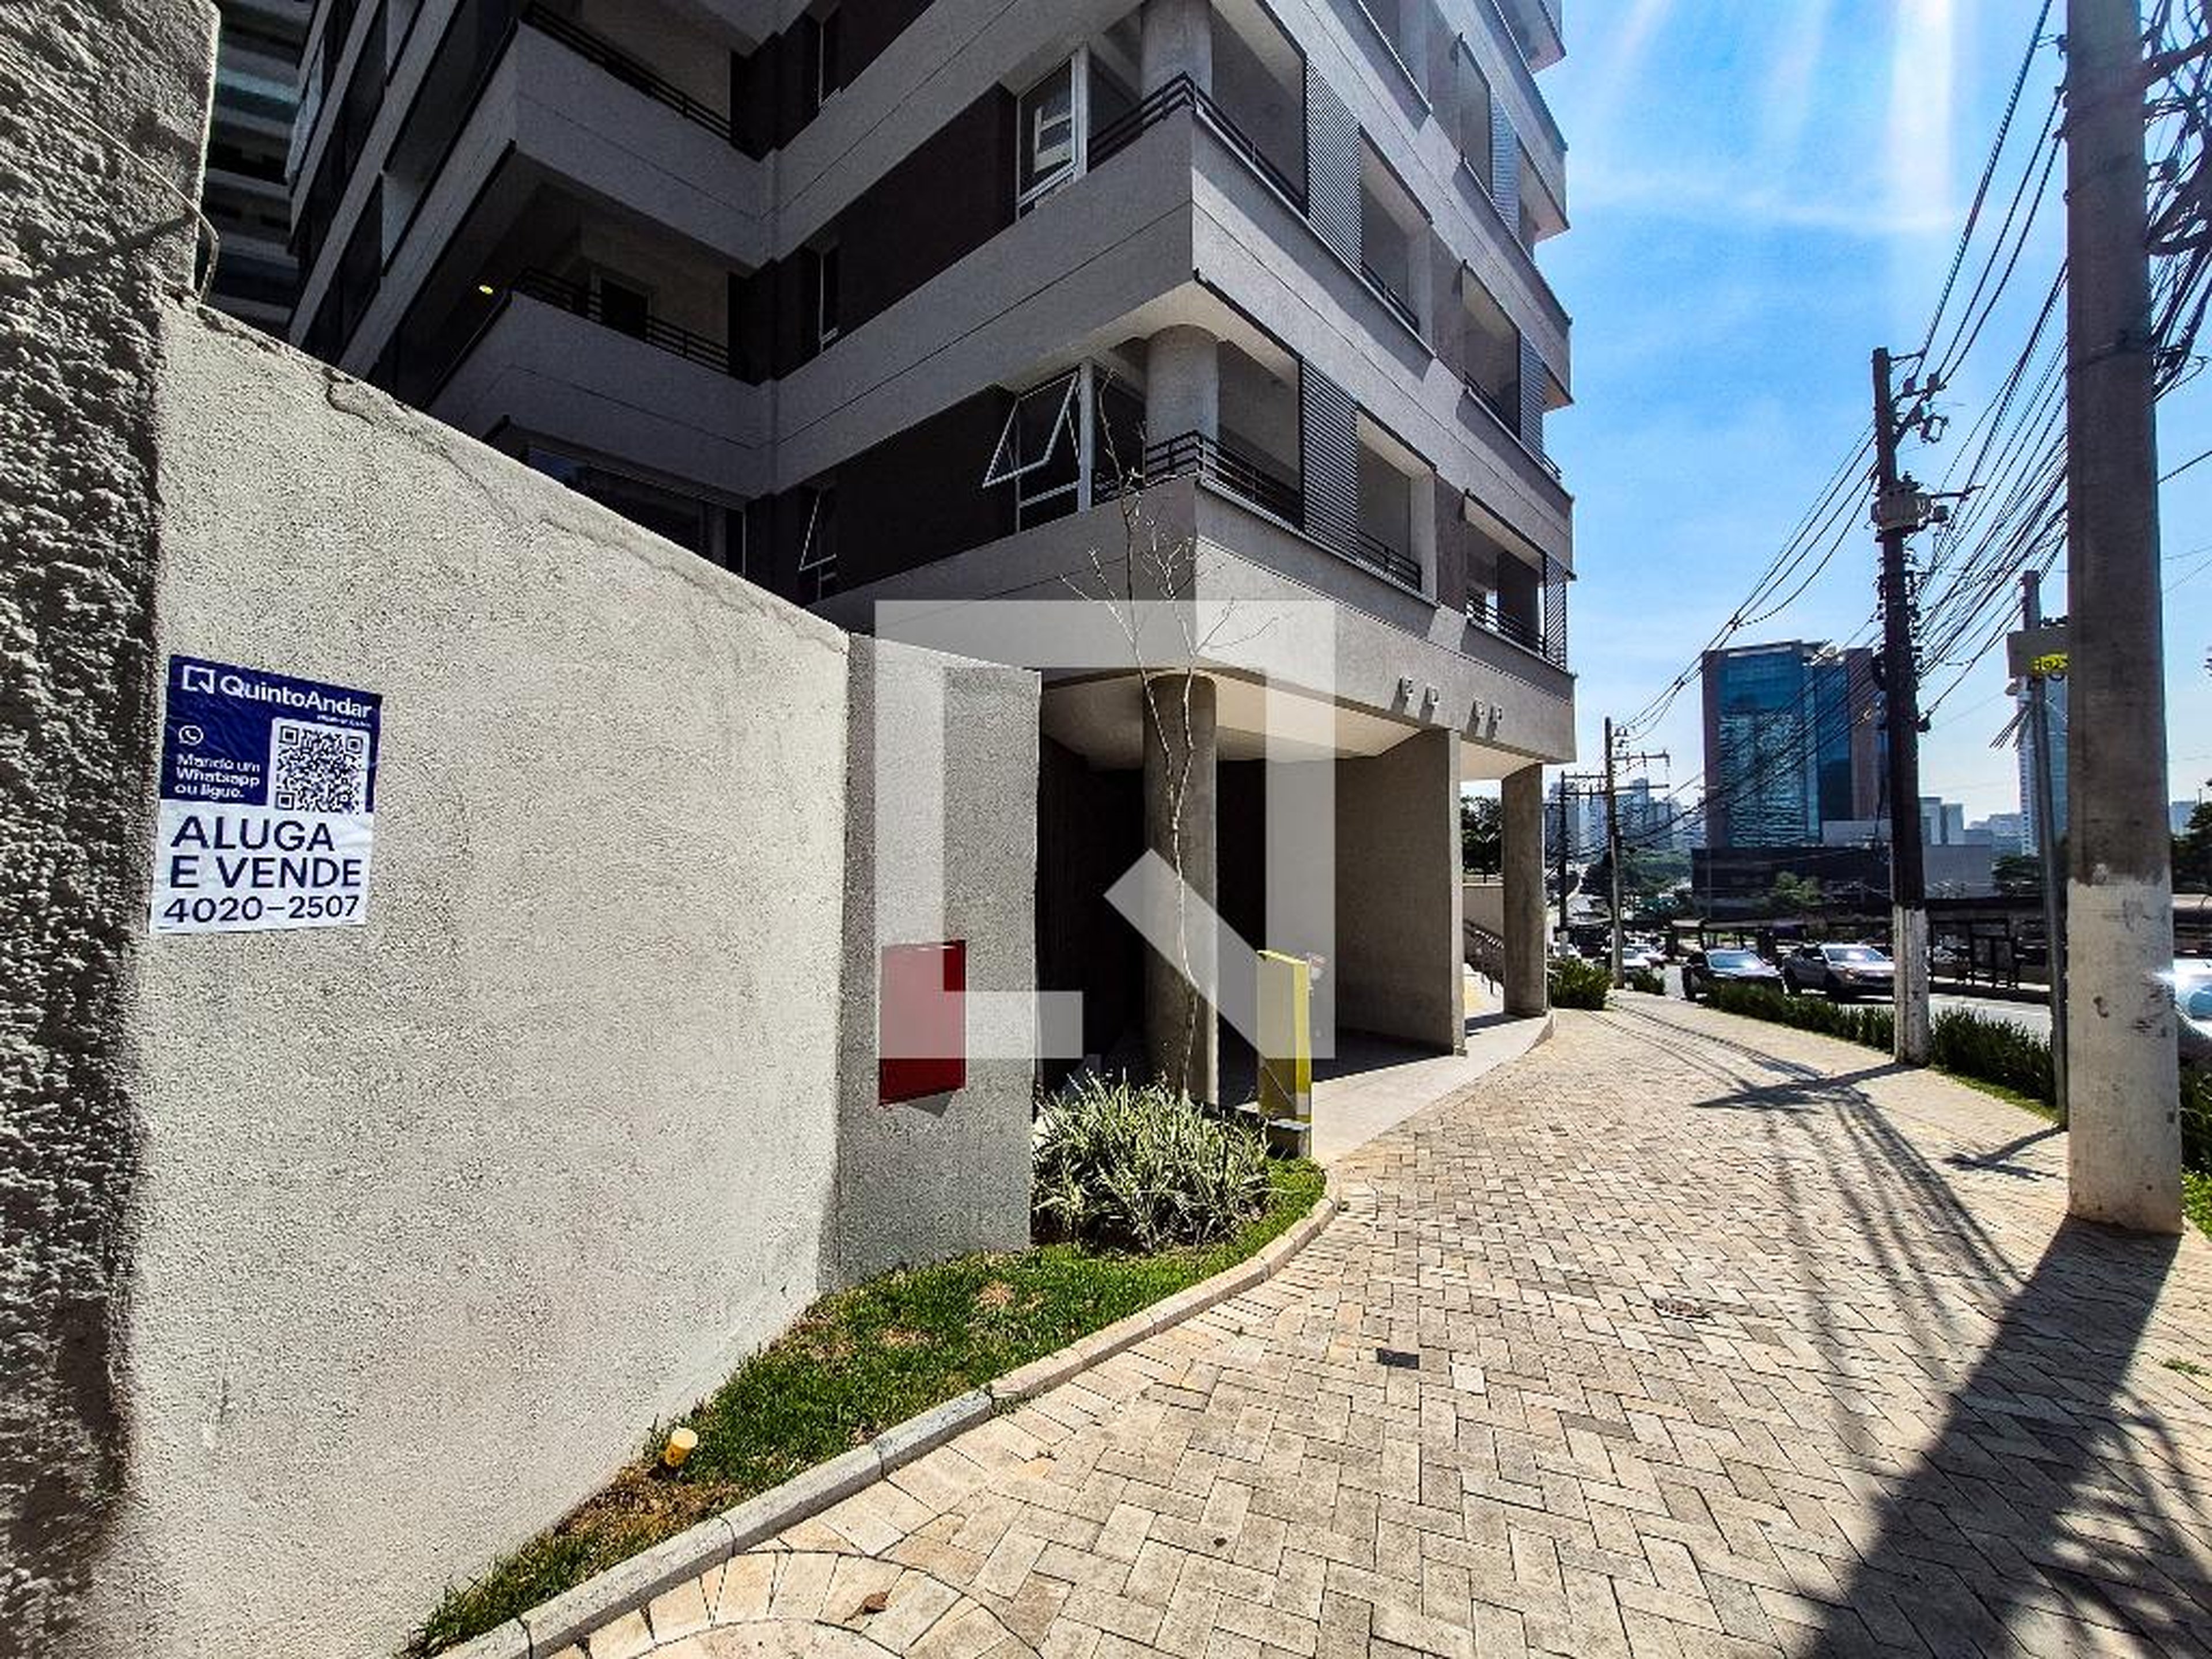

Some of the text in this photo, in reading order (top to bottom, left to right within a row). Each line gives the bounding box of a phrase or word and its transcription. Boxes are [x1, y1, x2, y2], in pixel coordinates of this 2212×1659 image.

[220, 675, 372, 718] QuintoAndar
[237, 762, 260, 772] um
[174, 784, 198, 795] ou
[170, 815, 335, 851] ALUGA
[170, 855, 362, 888] E VENDE
[164, 895, 359, 923] 4020-2507
